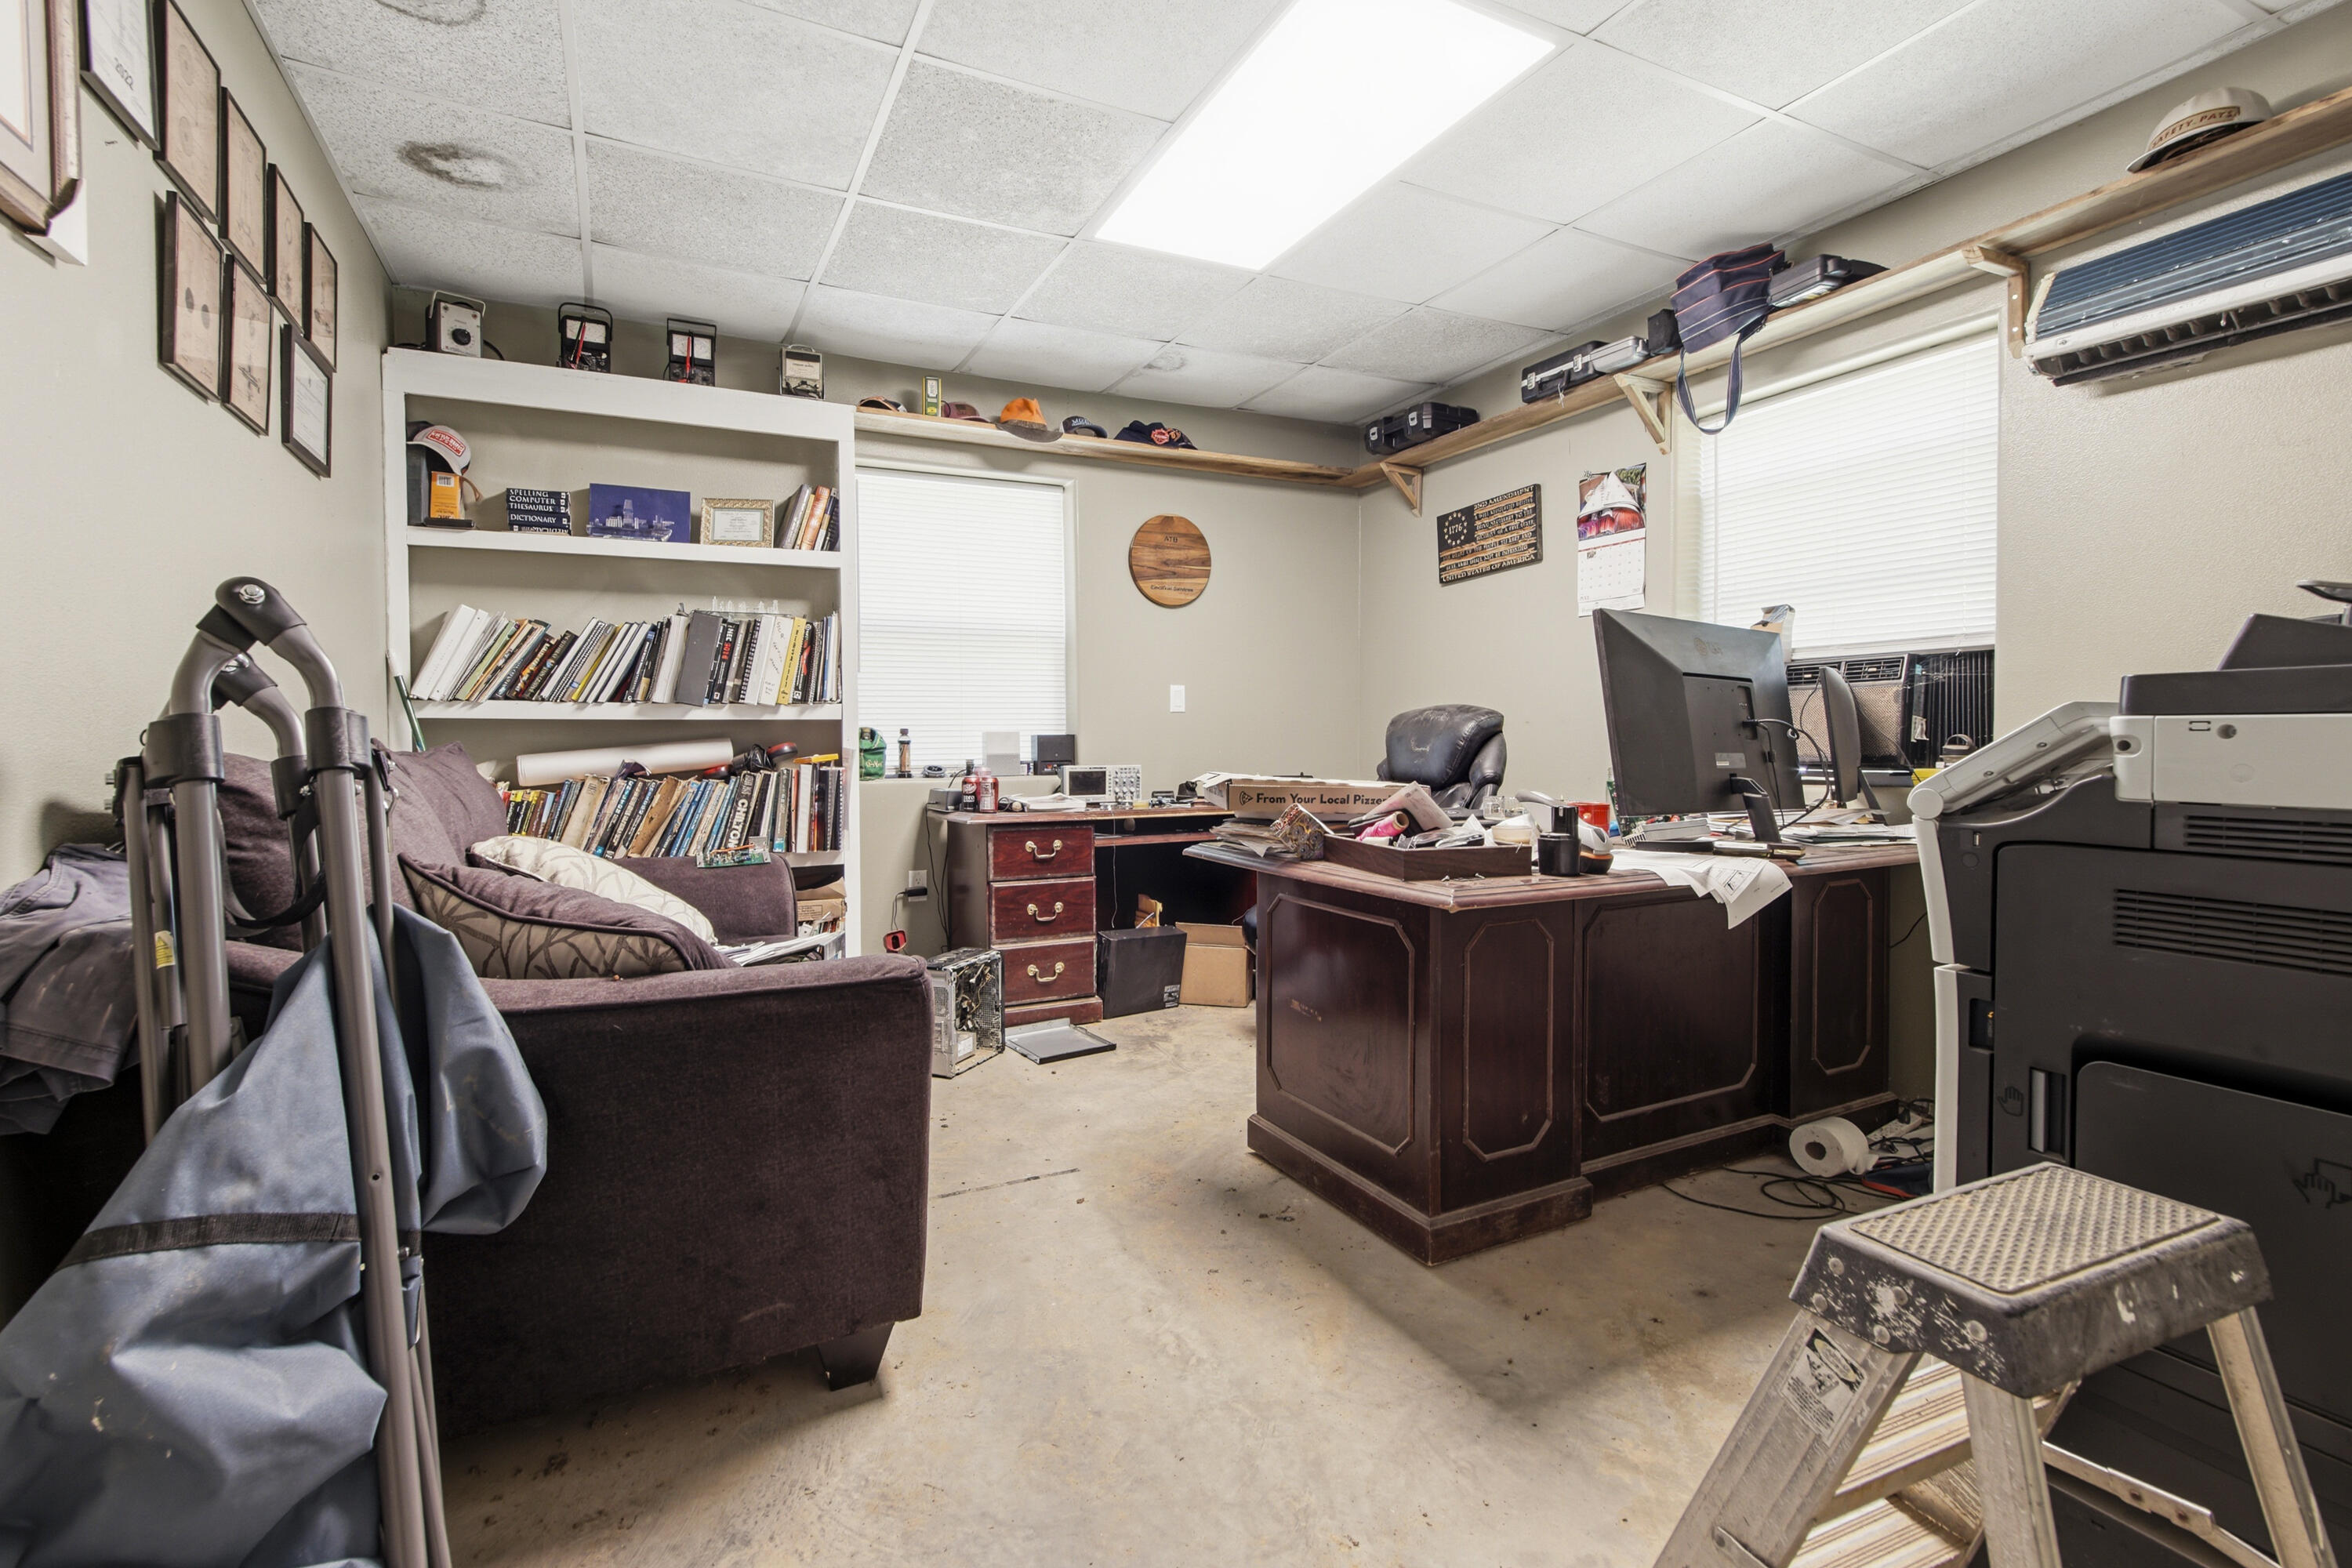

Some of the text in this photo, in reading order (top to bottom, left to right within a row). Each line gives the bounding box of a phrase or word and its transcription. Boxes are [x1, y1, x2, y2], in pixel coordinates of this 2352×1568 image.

[2152, 110, 2236, 148] SAFETY PAYS
[510, 495, 556, 504] COMPUTER
[1489, 485, 1534, 504] AMENDMENT
[509, 503, 554, 511] THESAURUS
[510, 514, 556, 523] DICTIONARY
[1449, 524, 1463, 534] 1776
[1442, 571, 1465, 582] UNITED
[1466, 565, 1490, 575] STATES
[1501, 554, 1534, 566] AMERICA
[1257, 793, 1286, 804] From
[1290, 793, 1316, 804] Your
[1319, 794, 1349, 804] Local
[726, 797, 749, 849] CHILTON
